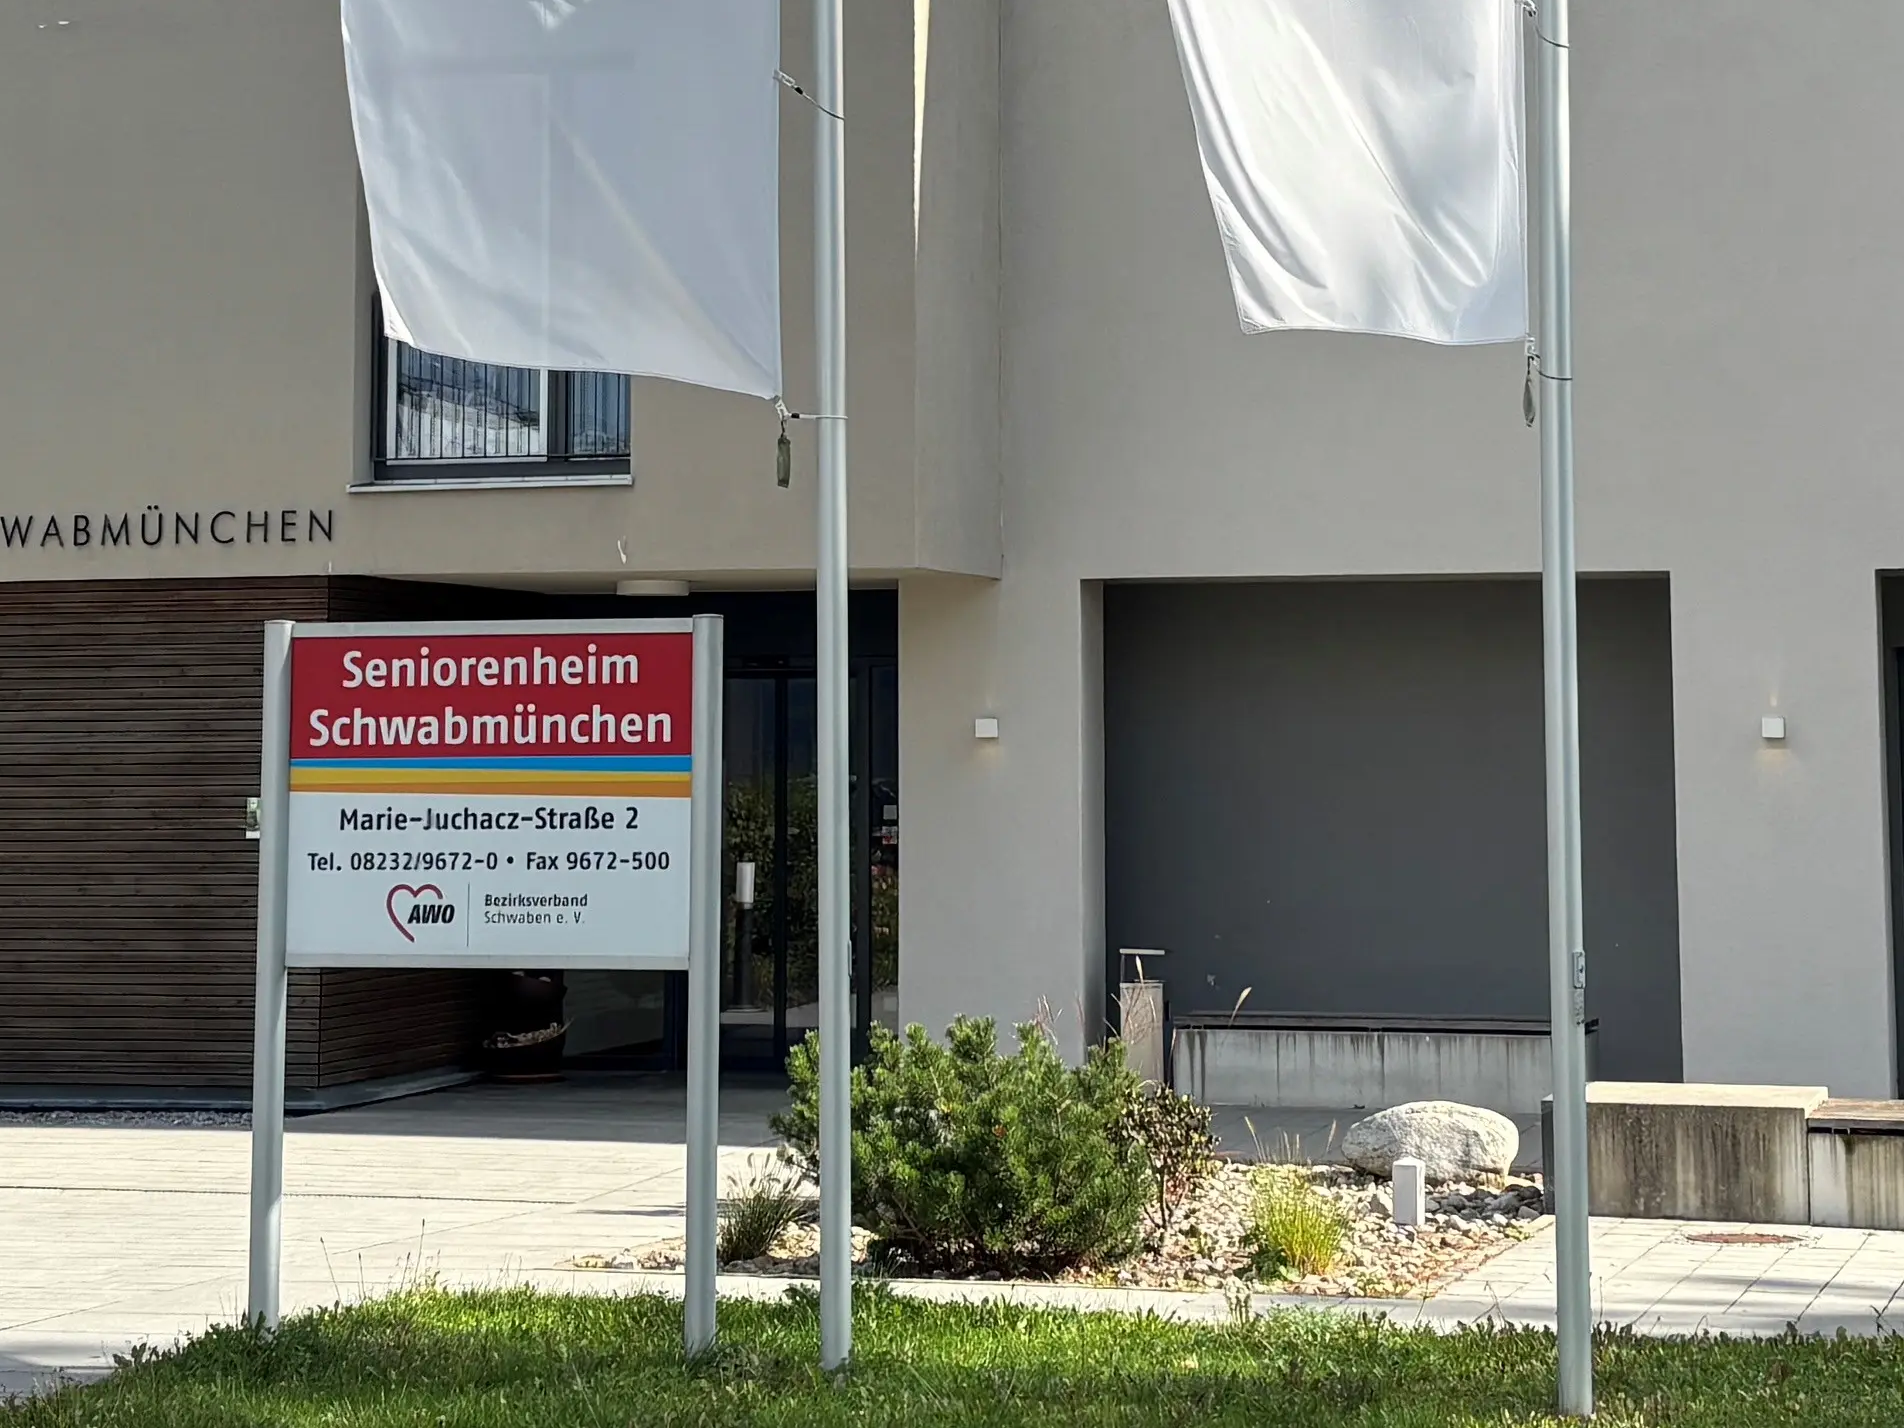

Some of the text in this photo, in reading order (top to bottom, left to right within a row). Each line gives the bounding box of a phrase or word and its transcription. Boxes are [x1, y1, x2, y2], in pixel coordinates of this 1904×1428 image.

[341, 643, 640, 689] Seniorenheim
[308, 703, 673, 748] Schwabmünchen
[339, 806, 639, 832] Marie-Juchacz-Straße 2
[307, 851, 670, 872] Tel. 08232/9672-0 Fax 9672-500
[484, 893, 588, 907] Bezirksverband
[407, 904, 456, 925] AWO
[484, 911, 551, 924] Schwaben
[556, 914, 568, 924] e.
